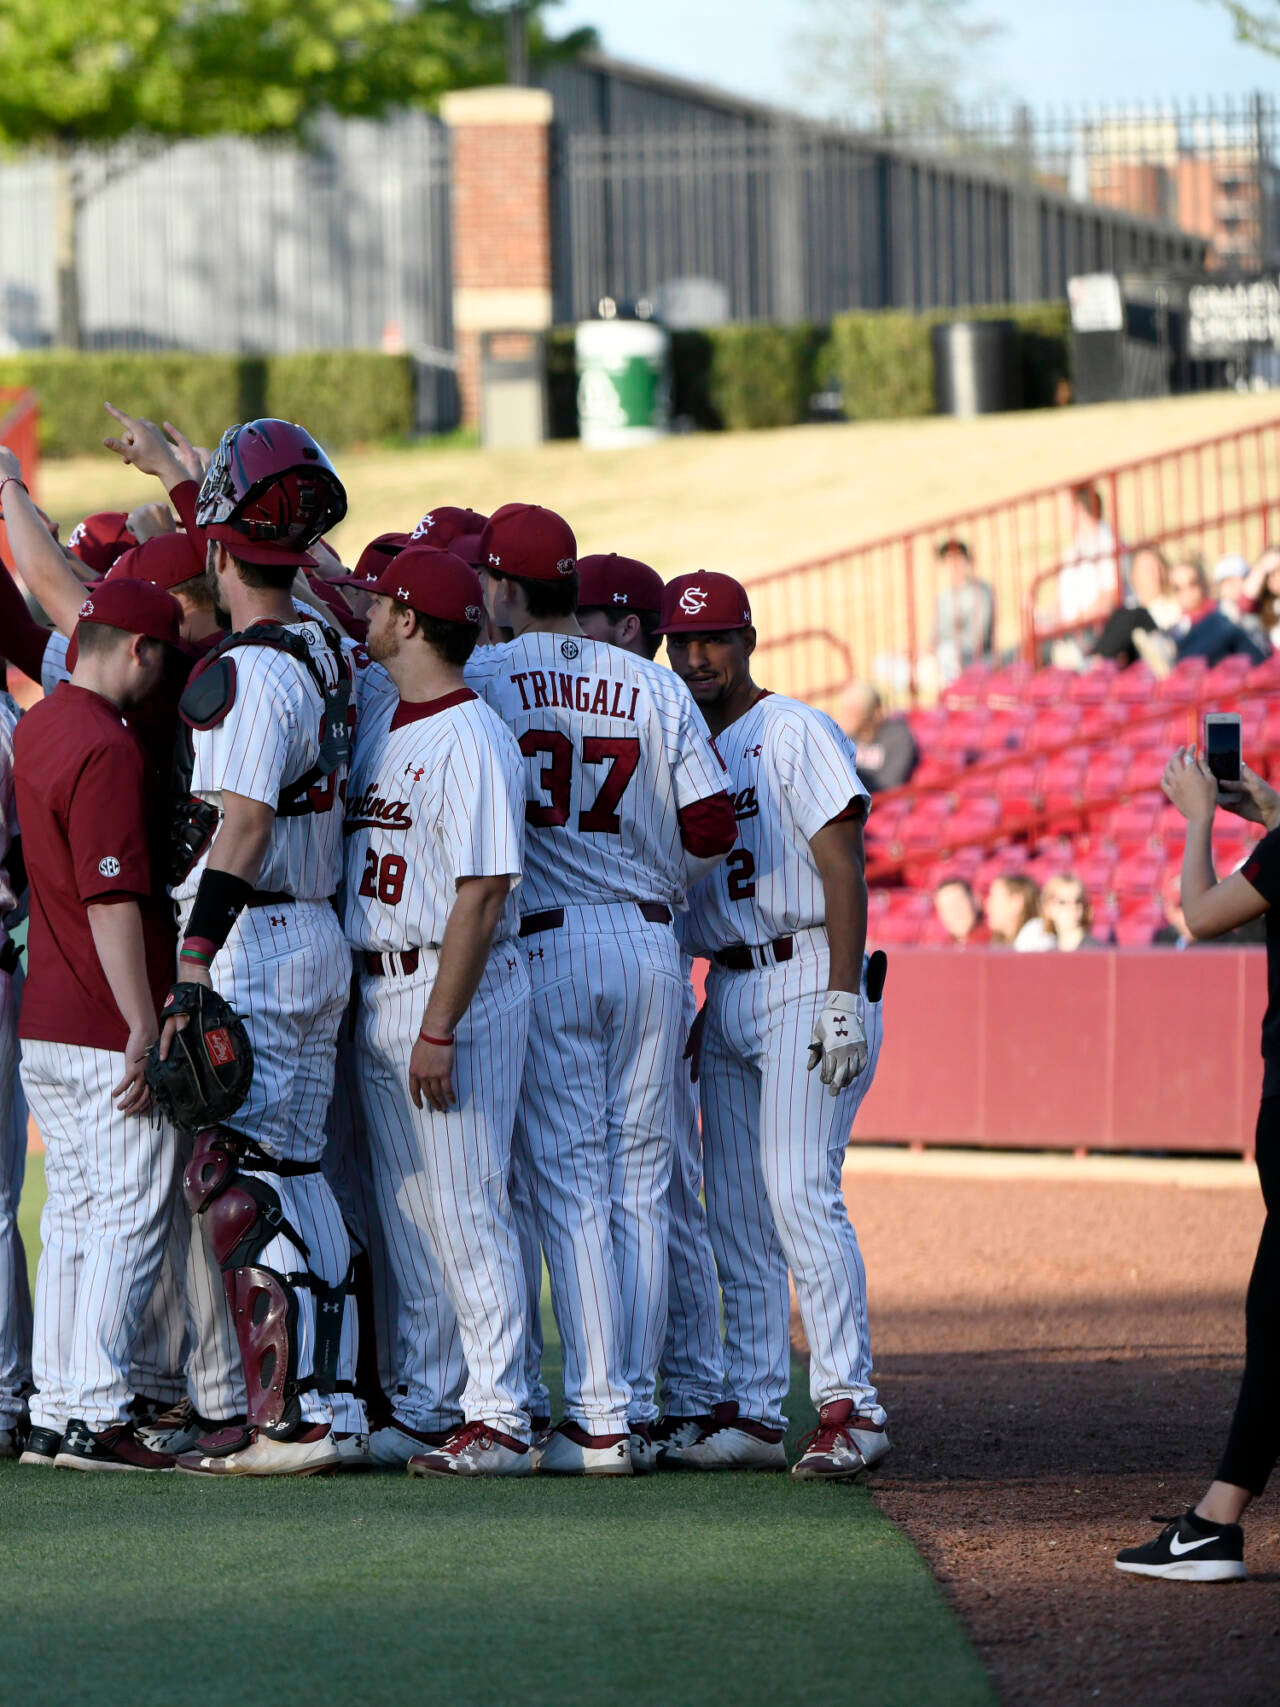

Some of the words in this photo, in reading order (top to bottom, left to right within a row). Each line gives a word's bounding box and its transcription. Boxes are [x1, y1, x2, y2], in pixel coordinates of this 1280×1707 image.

[510, 670, 641, 722] TRINGALI
[518, 729, 641, 834] 37
[99, 856, 120, 877] SEC
[358, 846, 408, 906] 28
